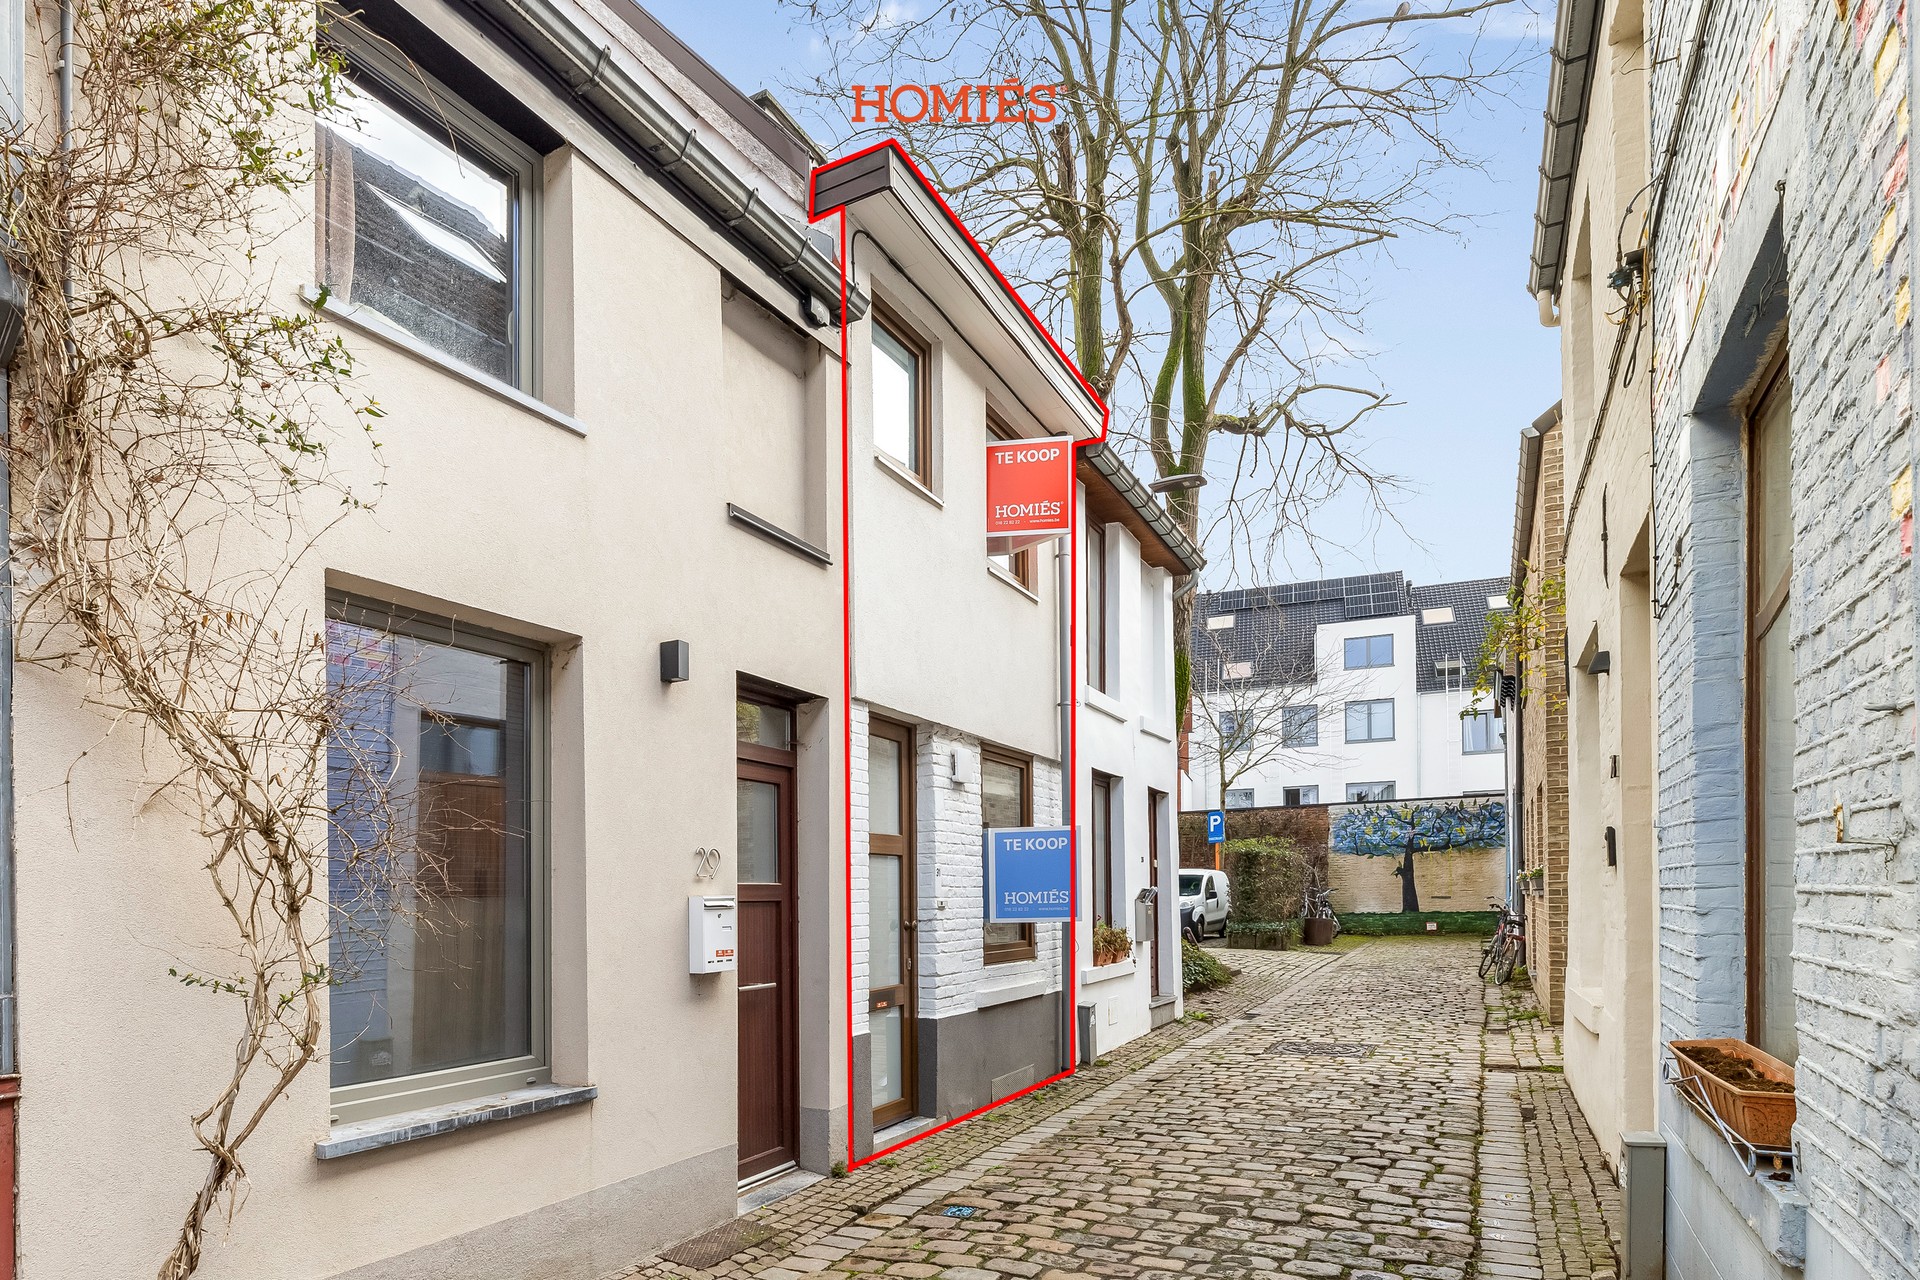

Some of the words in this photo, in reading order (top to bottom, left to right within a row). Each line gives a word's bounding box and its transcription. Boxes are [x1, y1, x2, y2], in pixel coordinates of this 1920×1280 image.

[995, 451, 1014, 465] TE
[1017, 448, 1060, 463] KOOP
[995, 500, 1061, 518] HOMIÉS
[1210, 815, 1221, 832] P
[1003, 838, 1021, 851] TE
[1025, 837, 1068, 851] KOOP
[696, 846, 721, 879] 29
[1004, 888, 1069, 905] HOMIÉS
